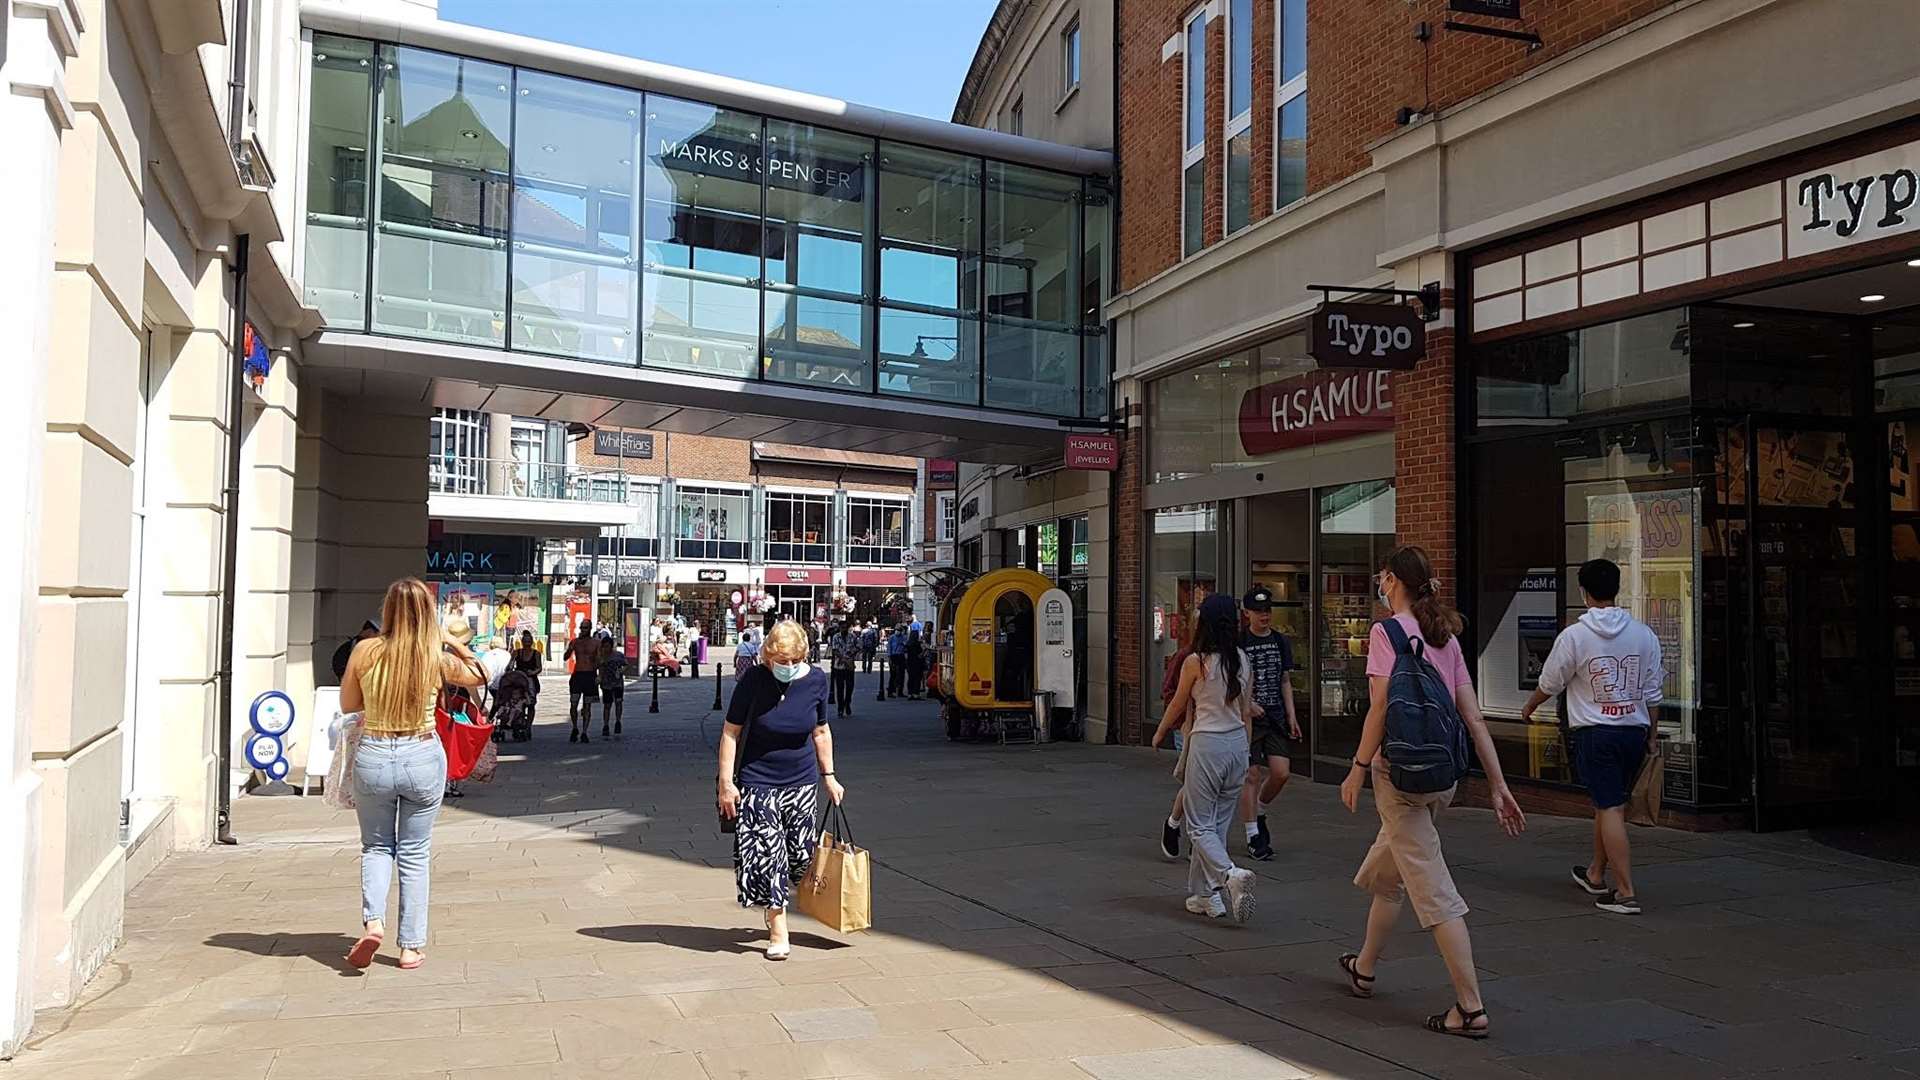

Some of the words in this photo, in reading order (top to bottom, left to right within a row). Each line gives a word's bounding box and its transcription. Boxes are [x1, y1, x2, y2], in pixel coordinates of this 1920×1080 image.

[660, 138, 734, 168] MARKS
[738, 153, 750, 171] &
[754, 157, 851, 189] SPENCER
[1799, 169, 1918, 236] Typ
[1328, 314, 1412, 357] Typo
[1271, 369, 1393, 433] H.SAMUE
[598, 432, 651, 453] Whitefriars
[1071, 440, 1114, 451] H.SAMUEL
[1075, 455, 1110, 465] JEWELLERS
[1588, 655, 1643, 703] 21
